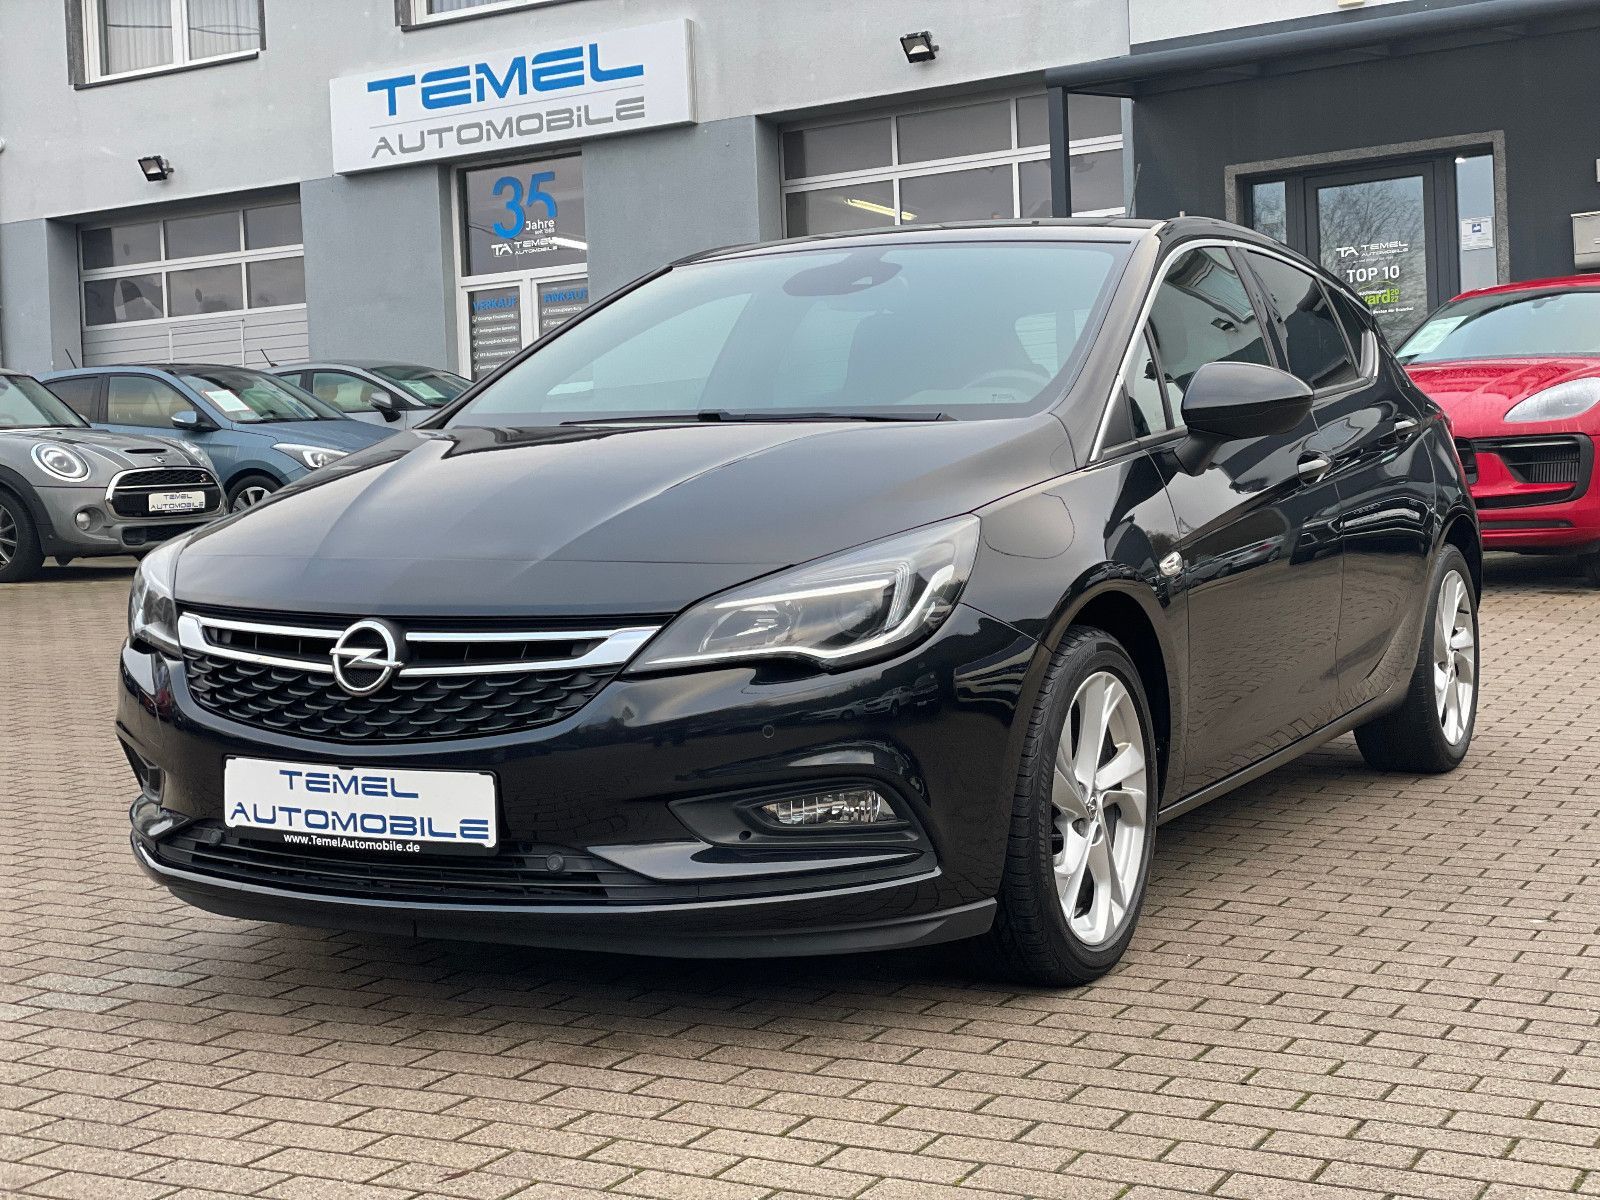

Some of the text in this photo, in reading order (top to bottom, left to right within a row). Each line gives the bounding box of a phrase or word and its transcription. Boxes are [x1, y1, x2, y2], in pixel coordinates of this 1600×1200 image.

[367, 43, 644, 116] TEMEL
[493, 171, 558, 238] 35
[526, 220, 555, 230] Jahre
[491, 243, 513, 256] TA
[1336, 246, 1359, 257] TA
[1361, 241, 1408, 250] TEMEL
[1346, 265, 1400, 282] TOP 10
[473, 295, 516, 311] VERKAUF
[151, 502, 204, 510] AUTOMOBILE
[279, 770, 418, 798] TEMEL
[230, 802, 489, 839] AUTOMOBILE
[284, 833, 420, 853] www.TemelAutomobile.de
